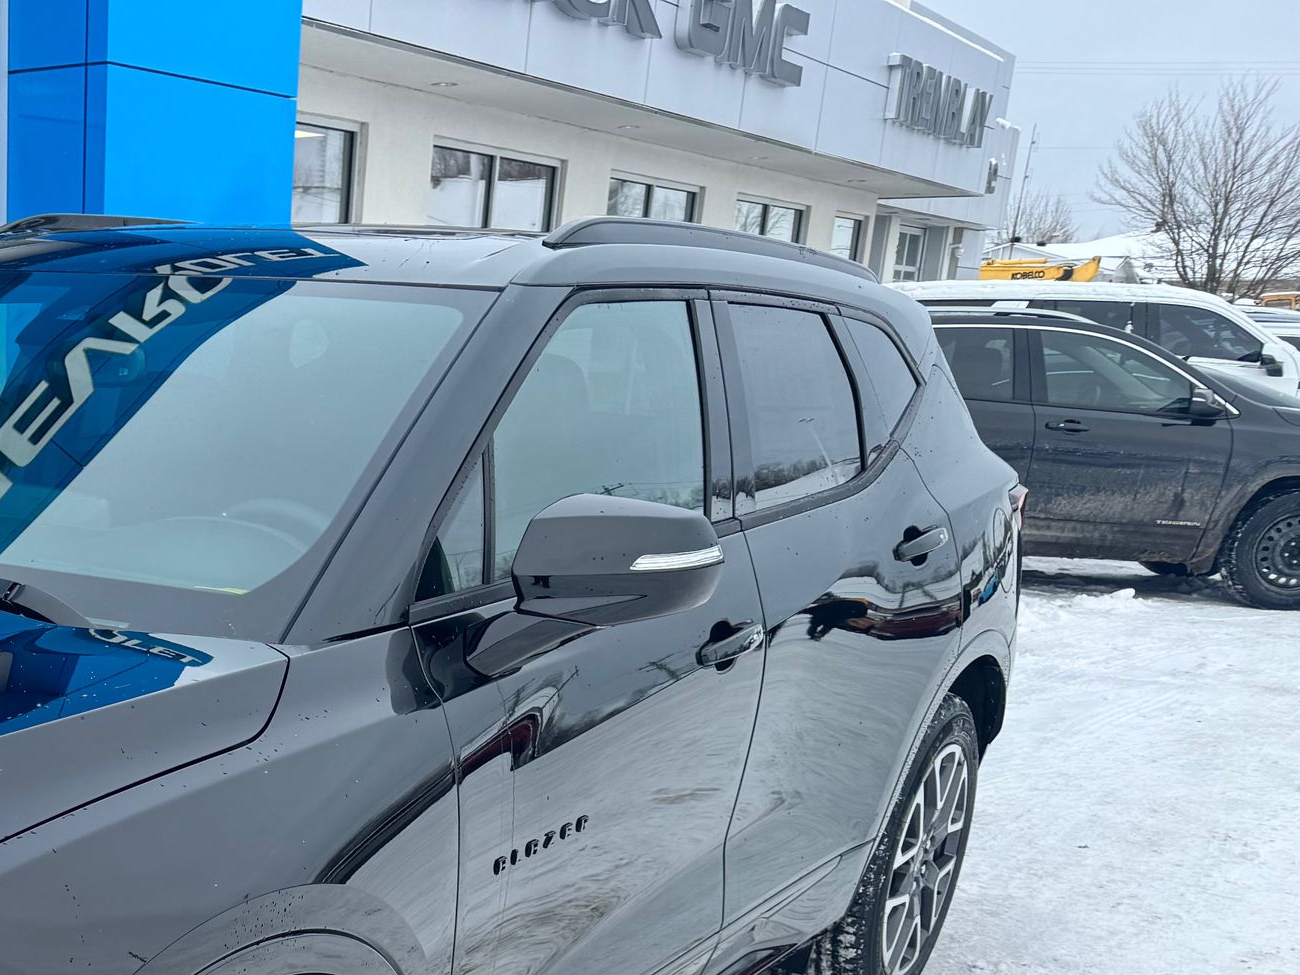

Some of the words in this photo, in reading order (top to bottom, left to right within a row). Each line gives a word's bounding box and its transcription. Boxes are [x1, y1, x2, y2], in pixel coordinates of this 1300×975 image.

[675, 0, 811, 88] GMC
[885, 53, 994, 148] TREMBLAY
[1011, 270, 1045, 280] KOBELCO
[493, 814, 590, 876] BLAZER
